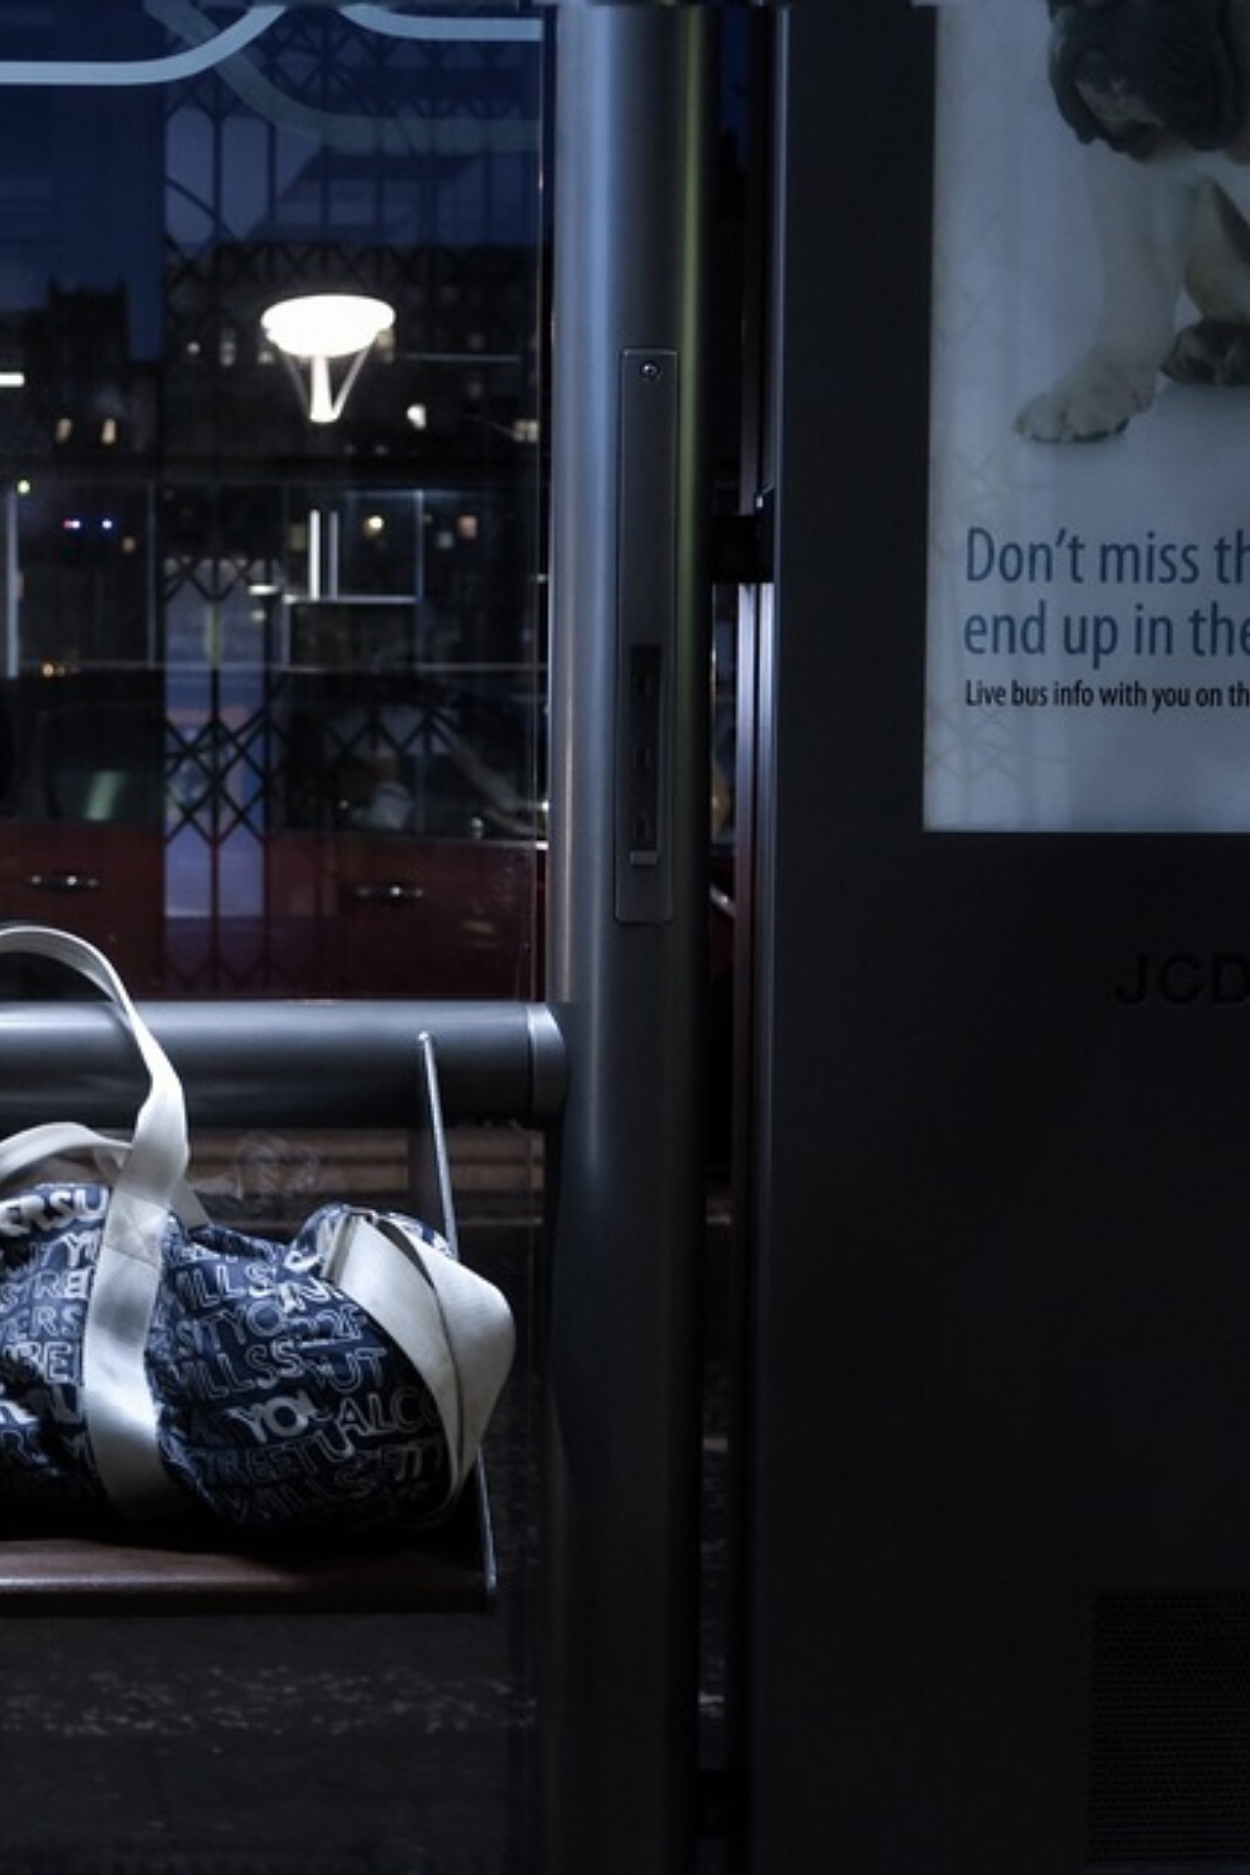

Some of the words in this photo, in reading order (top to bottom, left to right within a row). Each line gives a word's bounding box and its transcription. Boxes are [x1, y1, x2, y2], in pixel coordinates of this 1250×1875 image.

[966, 526, 1086, 584] Don’t
[1100, 530, 1200, 584] miss
[964, 599, 1047, 655] end
[1063, 614, 1118, 670] up
[1134, 603, 1173, 655] in
[1188, 600, 1250, 656] the
[965, 680, 1006, 706] Live
[1011, 679, 1048, 706] bus
[1053, 679, 1094, 706] info
[1100, 680, 1147, 706] with
[1152, 685, 1190, 713] you
[1196, 686, 1223, 706] on
